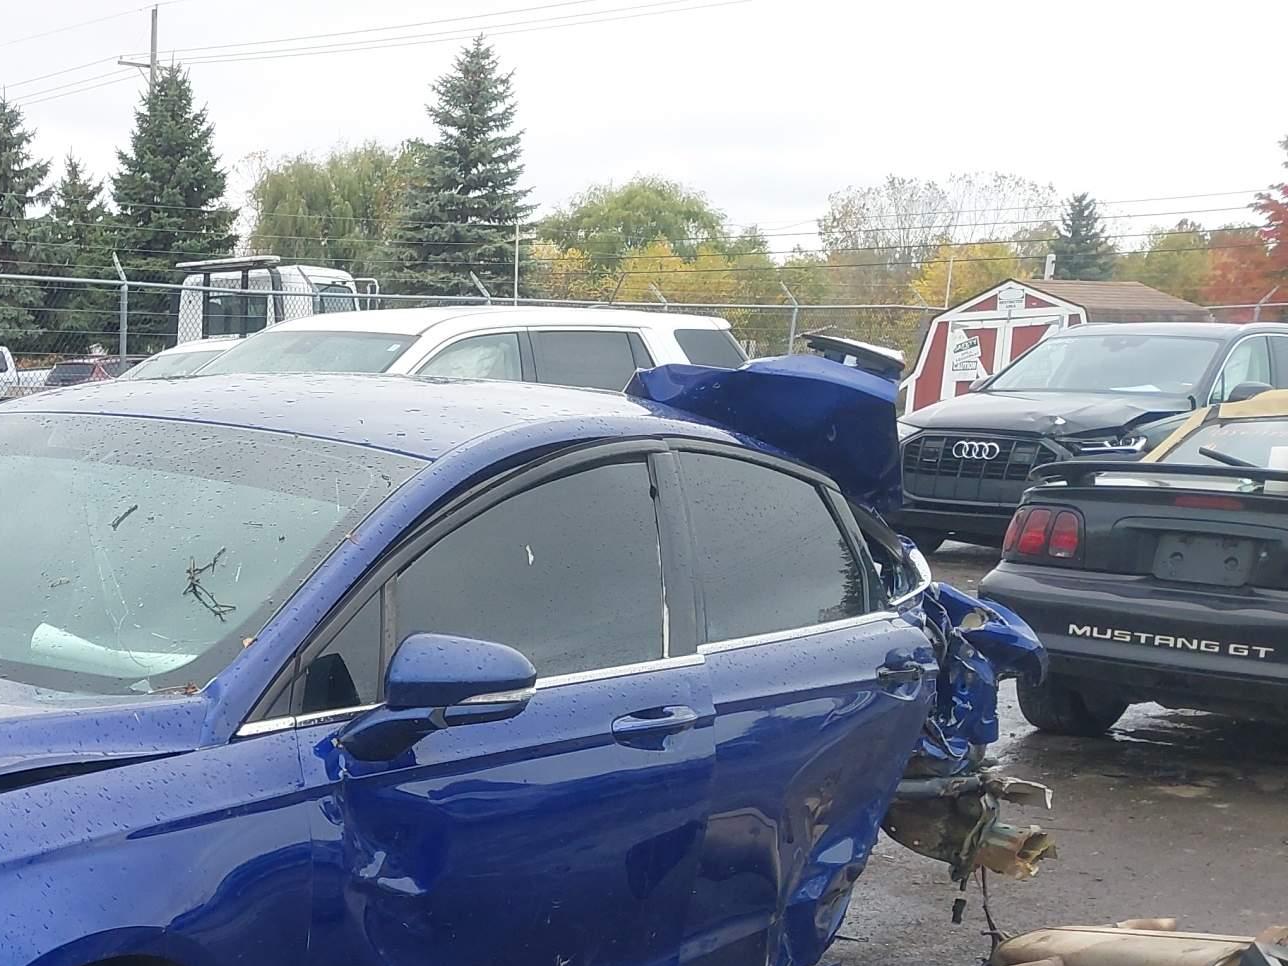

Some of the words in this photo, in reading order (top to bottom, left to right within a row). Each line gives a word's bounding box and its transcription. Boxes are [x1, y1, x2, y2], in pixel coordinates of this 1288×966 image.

[953, 361, 977, 370] CAUTION
[1068, 624, 1220, 653] MUSTANG
[1228, 643, 1274, 659] GT
